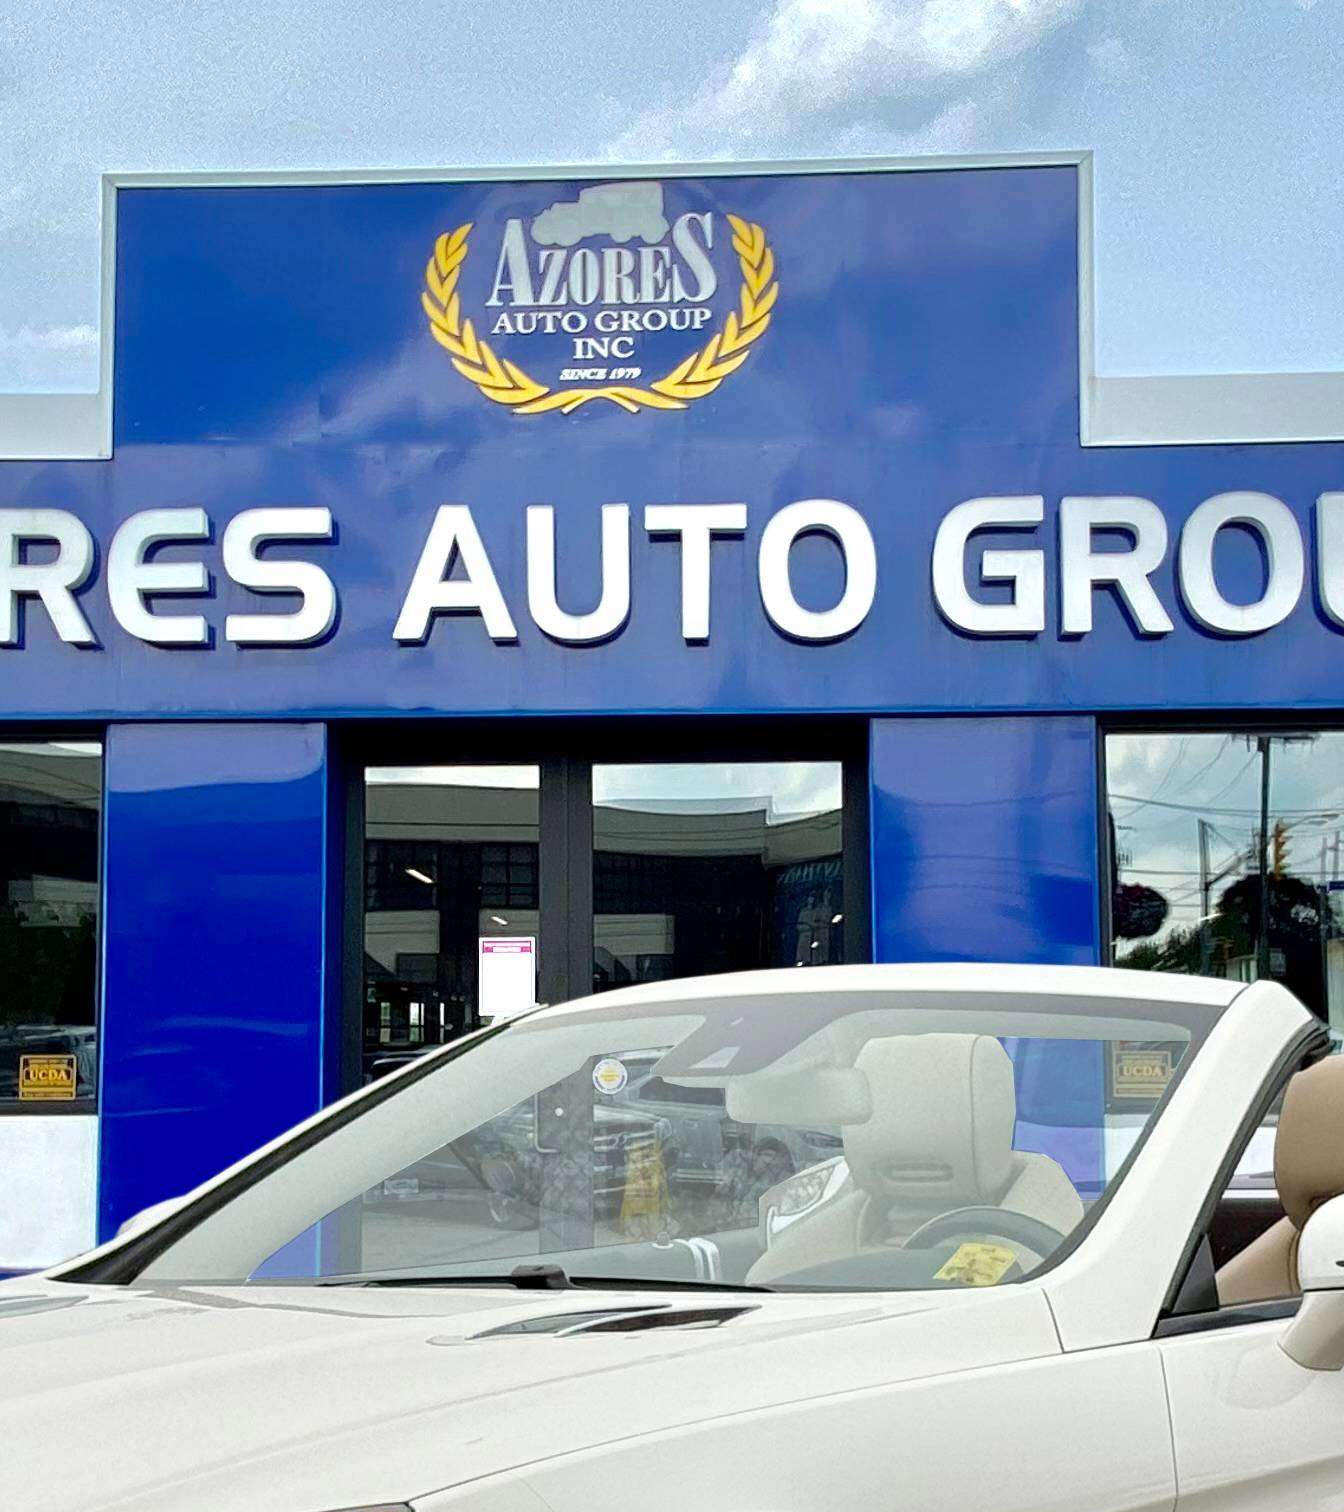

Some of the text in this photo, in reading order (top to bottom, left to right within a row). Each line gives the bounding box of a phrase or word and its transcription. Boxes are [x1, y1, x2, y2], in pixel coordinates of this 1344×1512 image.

[485, 211, 718, 307] AZORES
[491, 307, 713, 335] AUTO GROUP
[572, 336, 635, 360] INC
[559, 366, 642, 381] SINCE 1979
[392, 502, 877, 643] AUTO
[29, 1068, 67, 1081] UCDA
